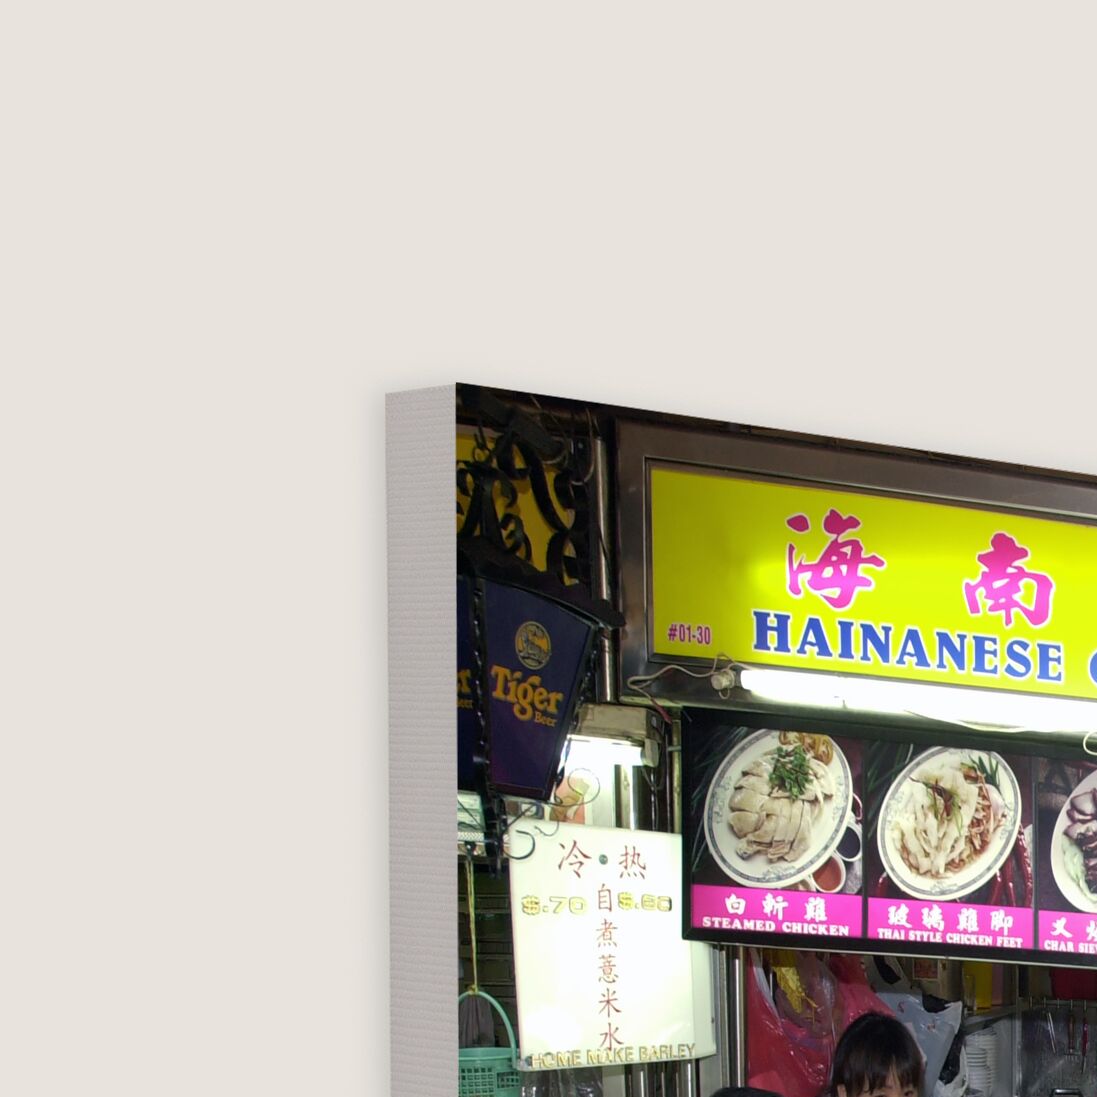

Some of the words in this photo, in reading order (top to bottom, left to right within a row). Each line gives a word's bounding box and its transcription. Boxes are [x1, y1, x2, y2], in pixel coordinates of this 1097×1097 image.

[667, 624, 711, 646] #01-30
[753, 611, 1062, 681] HAINANESE
[491, 663, 564, 721] Tiger
[534, 711, 557, 728] Beer
[702, 916, 776, 932] STEAMED
[782, 921, 850, 936] CHICKEN
[877, 927, 905, 940] THAI
[908, 930, 942, 943] STYLE
[946, 934, 993, 947] CHICKEN
[997, 937, 1023, 949] FEET
[1044, 940, 1075, 953] CHAR
[530, 1050, 582, 1069] HOME
[586, 1046, 633, 1063] MAKE
[639, 1043, 696, 1060] BARLEY
